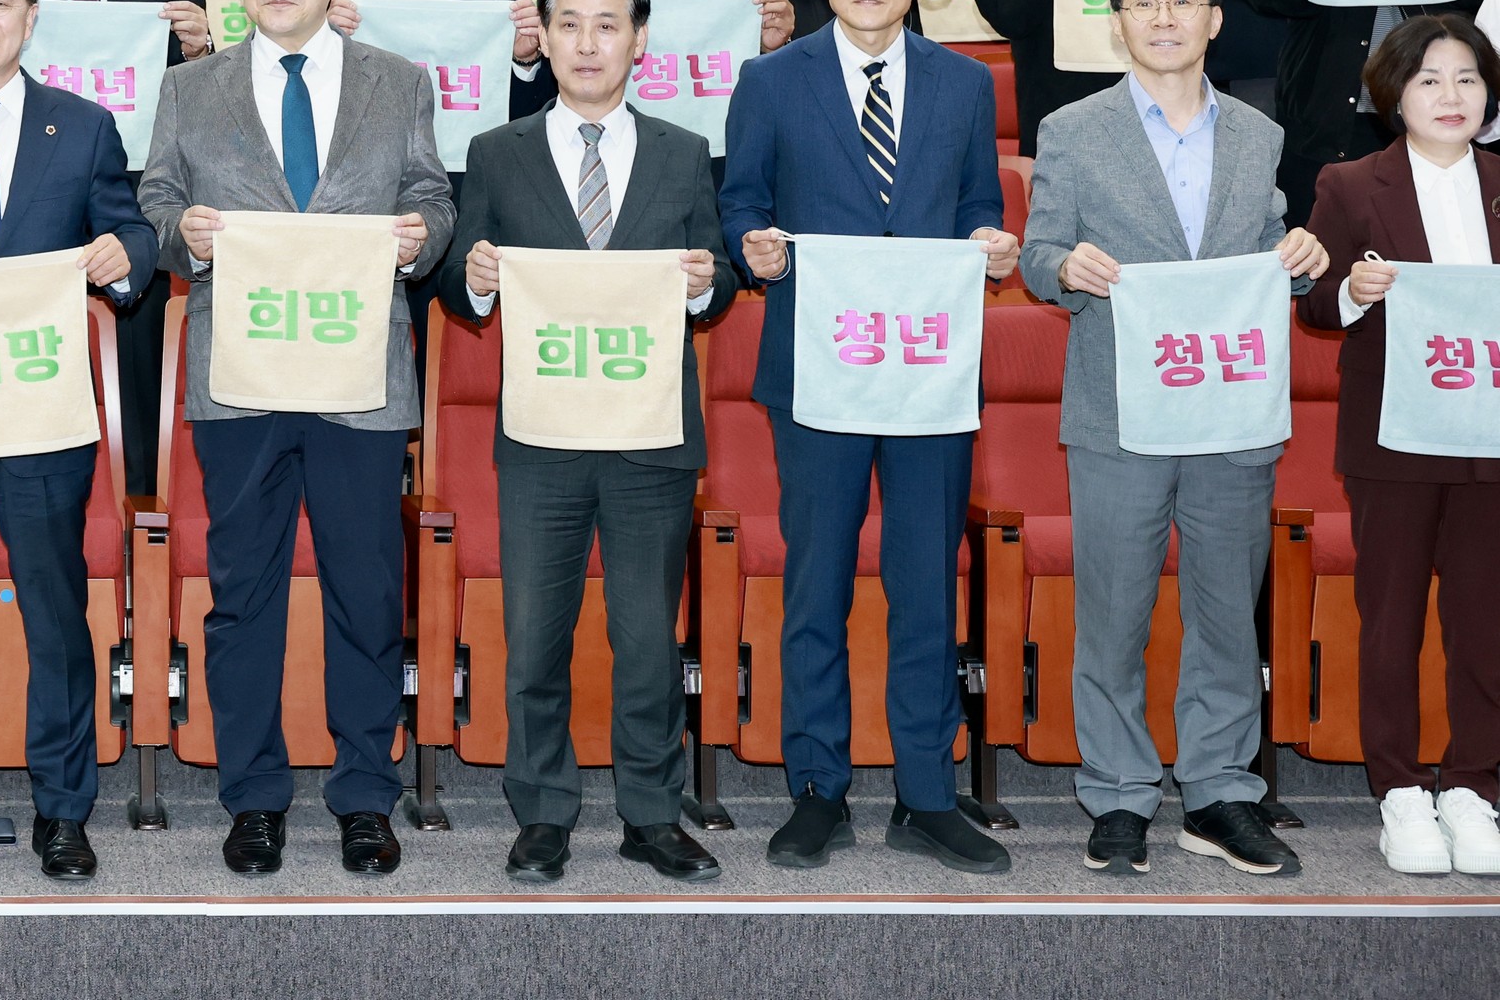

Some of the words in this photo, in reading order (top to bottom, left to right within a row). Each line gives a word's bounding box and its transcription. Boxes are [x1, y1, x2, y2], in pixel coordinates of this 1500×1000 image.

[430, 65, 482, 113] 년
[630, 52, 734, 102] 청년
[246, 285, 365, 346] 희망
[832, 308, 950, 367] 청년
[534, 322, 656, 382] 희망
[1152, 327, 1268, 389] 청년
